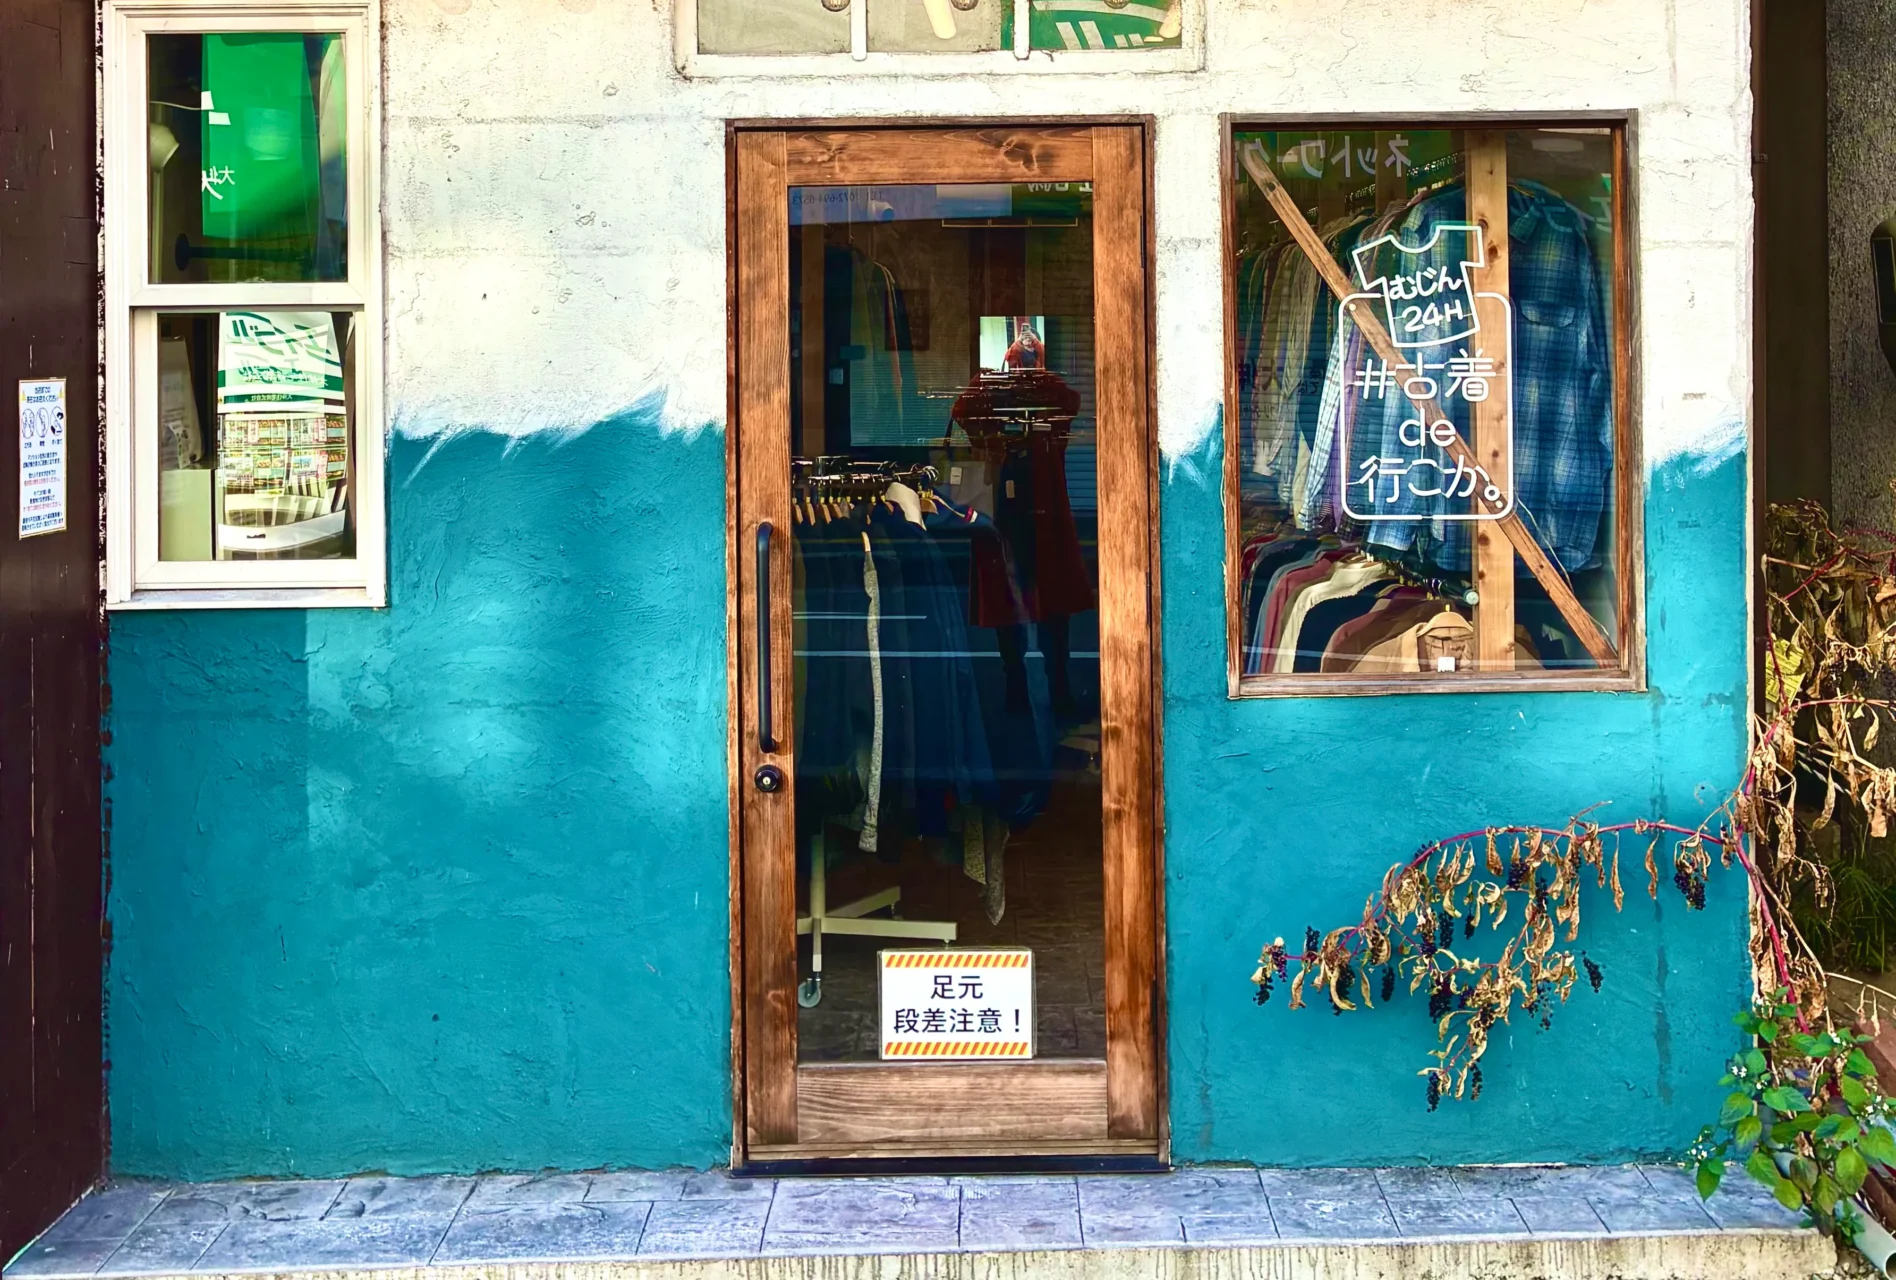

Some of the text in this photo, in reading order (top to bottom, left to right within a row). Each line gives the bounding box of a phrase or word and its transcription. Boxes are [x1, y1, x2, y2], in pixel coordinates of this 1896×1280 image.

[1388, 266, 1462, 301] むじん
[1402, 299, 1464, 333] 24H
[1354, 348, 1497, 402] #古着
[1398, 407, 1457, 448] de
[1359, 455, 1501, 503] 行こか。
[930, 974, 984, 1000] 足元
[893, 1006, 1021, 1035] 段差注意！
